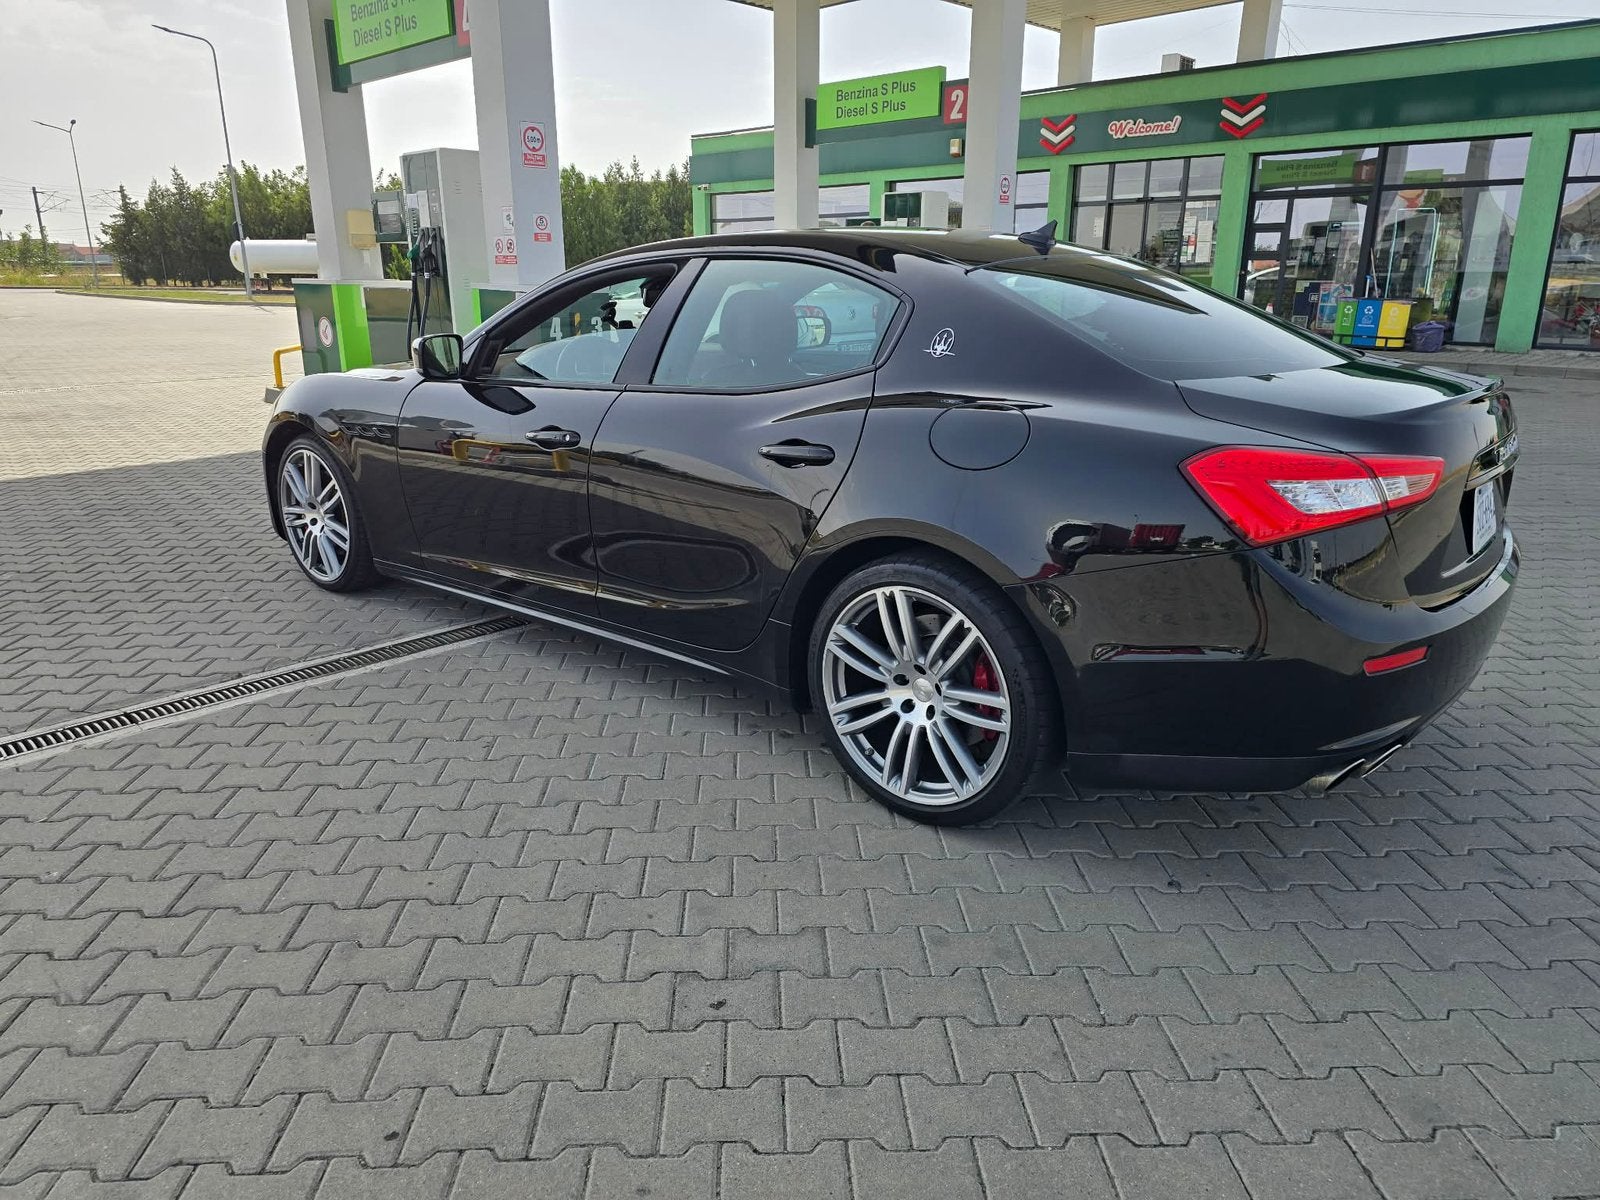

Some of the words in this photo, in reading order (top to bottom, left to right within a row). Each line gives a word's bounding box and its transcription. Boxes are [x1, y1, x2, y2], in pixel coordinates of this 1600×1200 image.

[350, 0, 389, 22] Benzina
[353, 22, 382, 46] Diesel
[384, 19, 392, 36] S
[394, 14, 418, 35] Plus
[836, 86, 878, 102] Benzina
[881, 83, 889, 96] S
[891, 80, 916, 94] Plus
[836, 102, 868, 119] Diesel
[871, 102, 878, 114] S
[881, 99, 906, 113] Plus
[949, 89, 964, 120] 2
[1108, 115, 1182, 138] Welcome!
[550, 316, 563, 341] 4
[591, 316, 603, 337] 3
